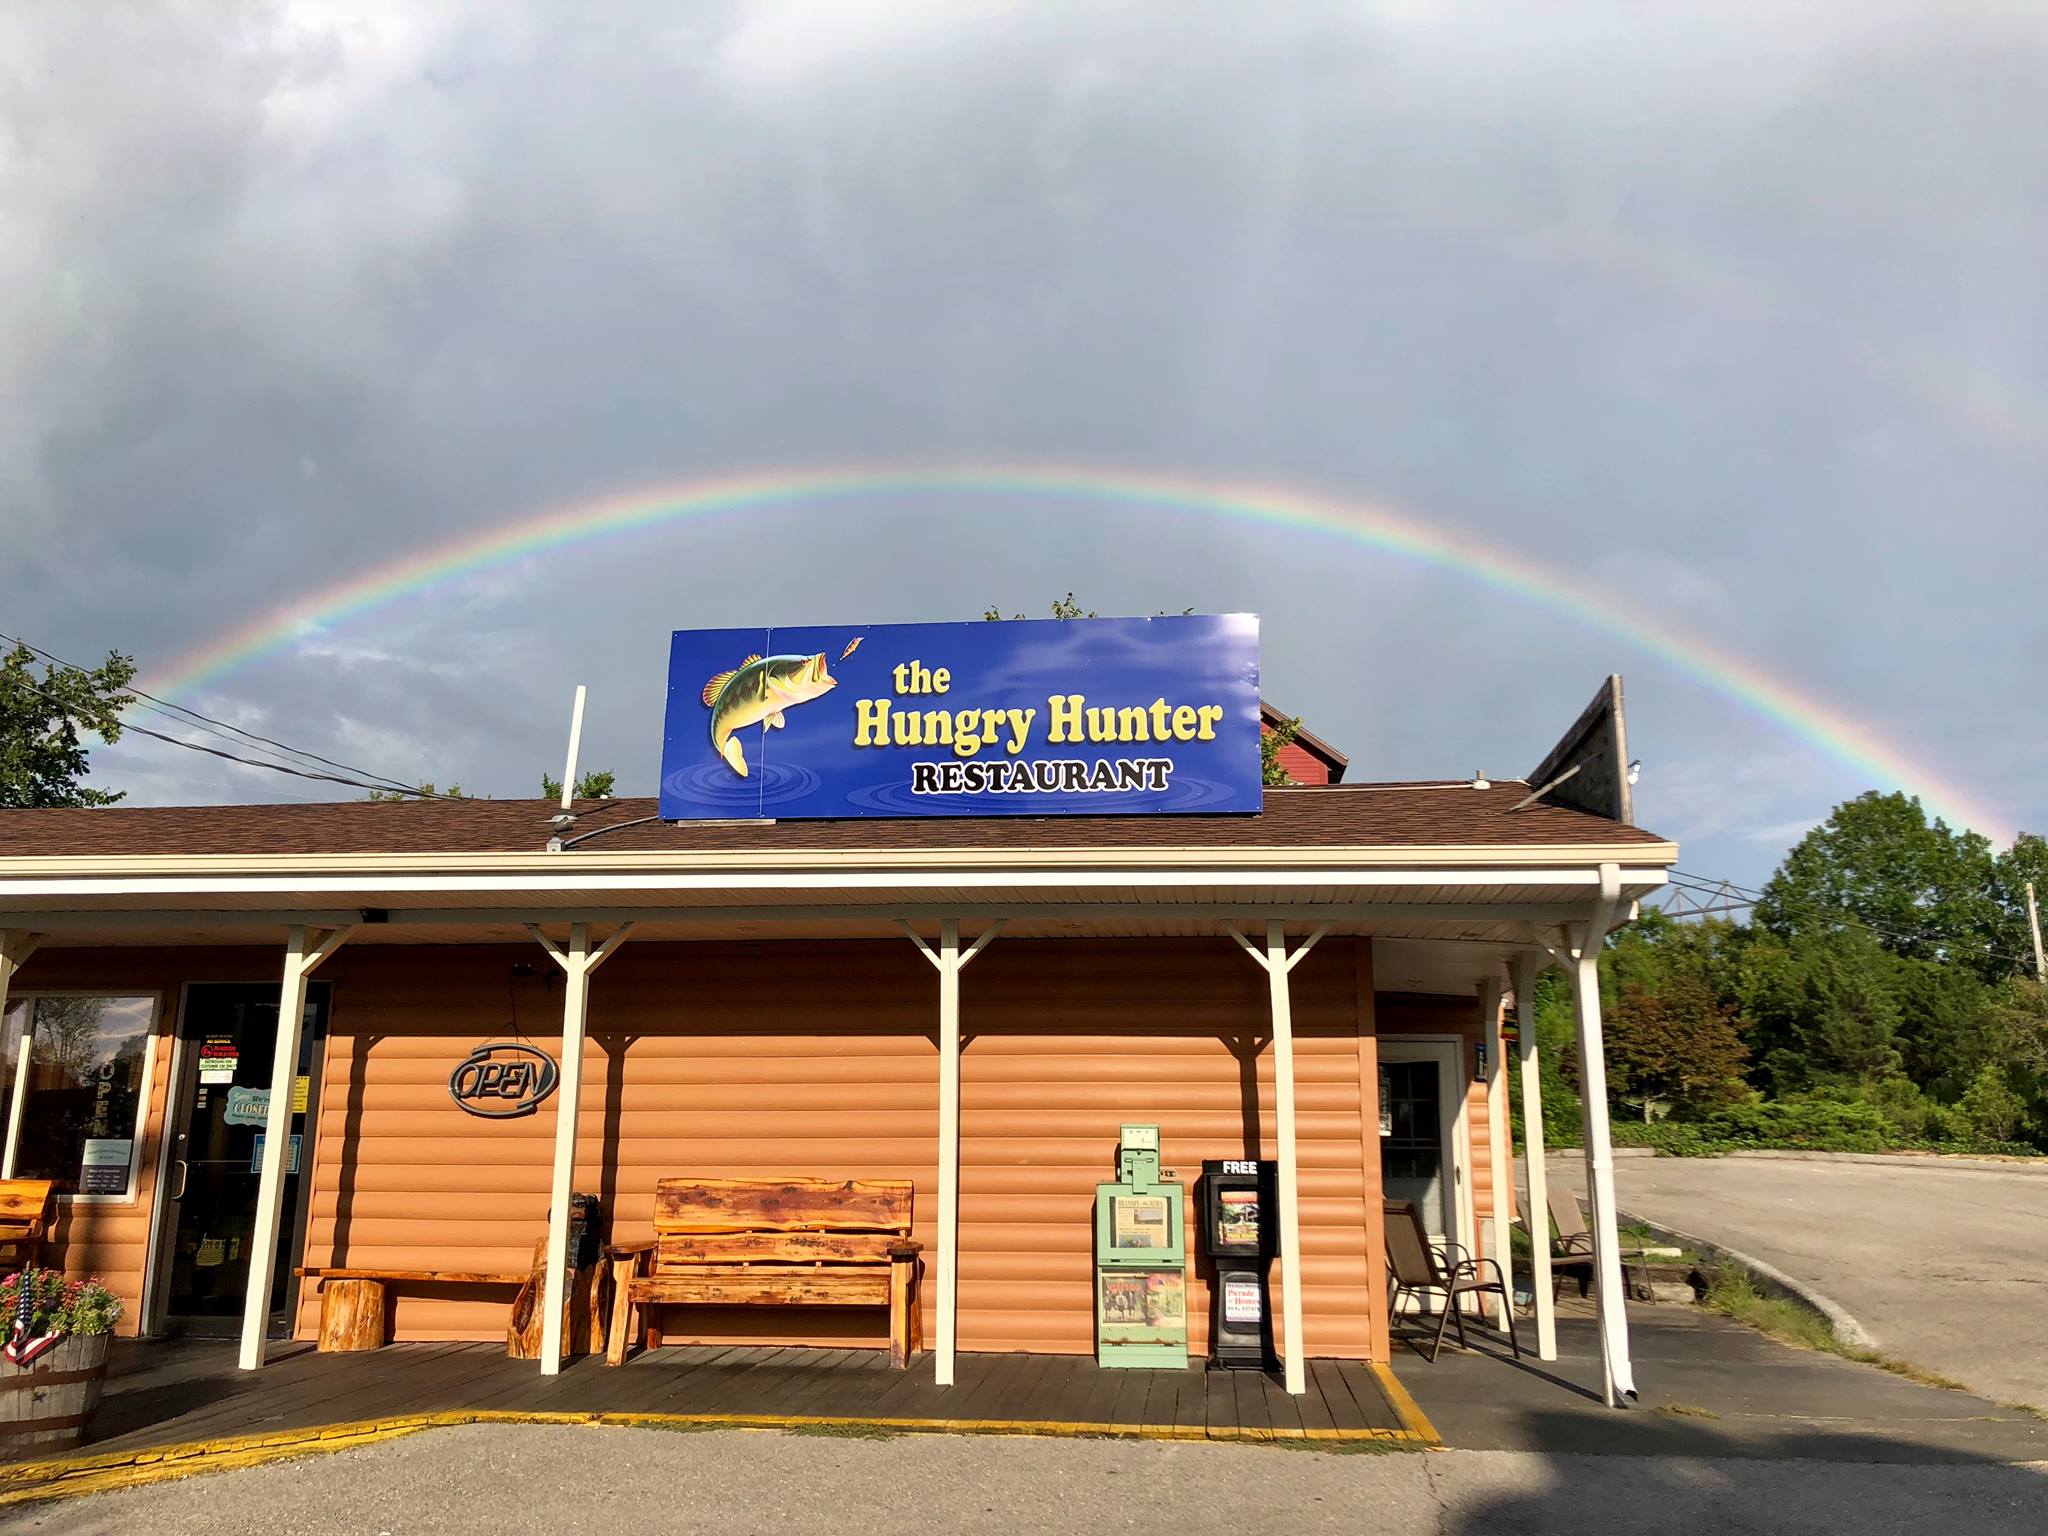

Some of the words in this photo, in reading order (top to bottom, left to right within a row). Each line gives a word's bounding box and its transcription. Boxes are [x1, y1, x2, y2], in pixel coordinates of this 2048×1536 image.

[893, 660, 950, 694] the
[854, 699, 1036, 756] Hungry
[1048, 695, 1223, 741] Hunter
[912, 760, 1172, 793] RESTAURANT
[455, 1062, 547, 1097] OPEN
[1223, 1161, 1257, 1174] FREE
[1228, 1289, 1255, 1297] Parade
[1235, 1297, 1261, 1305] Homes
